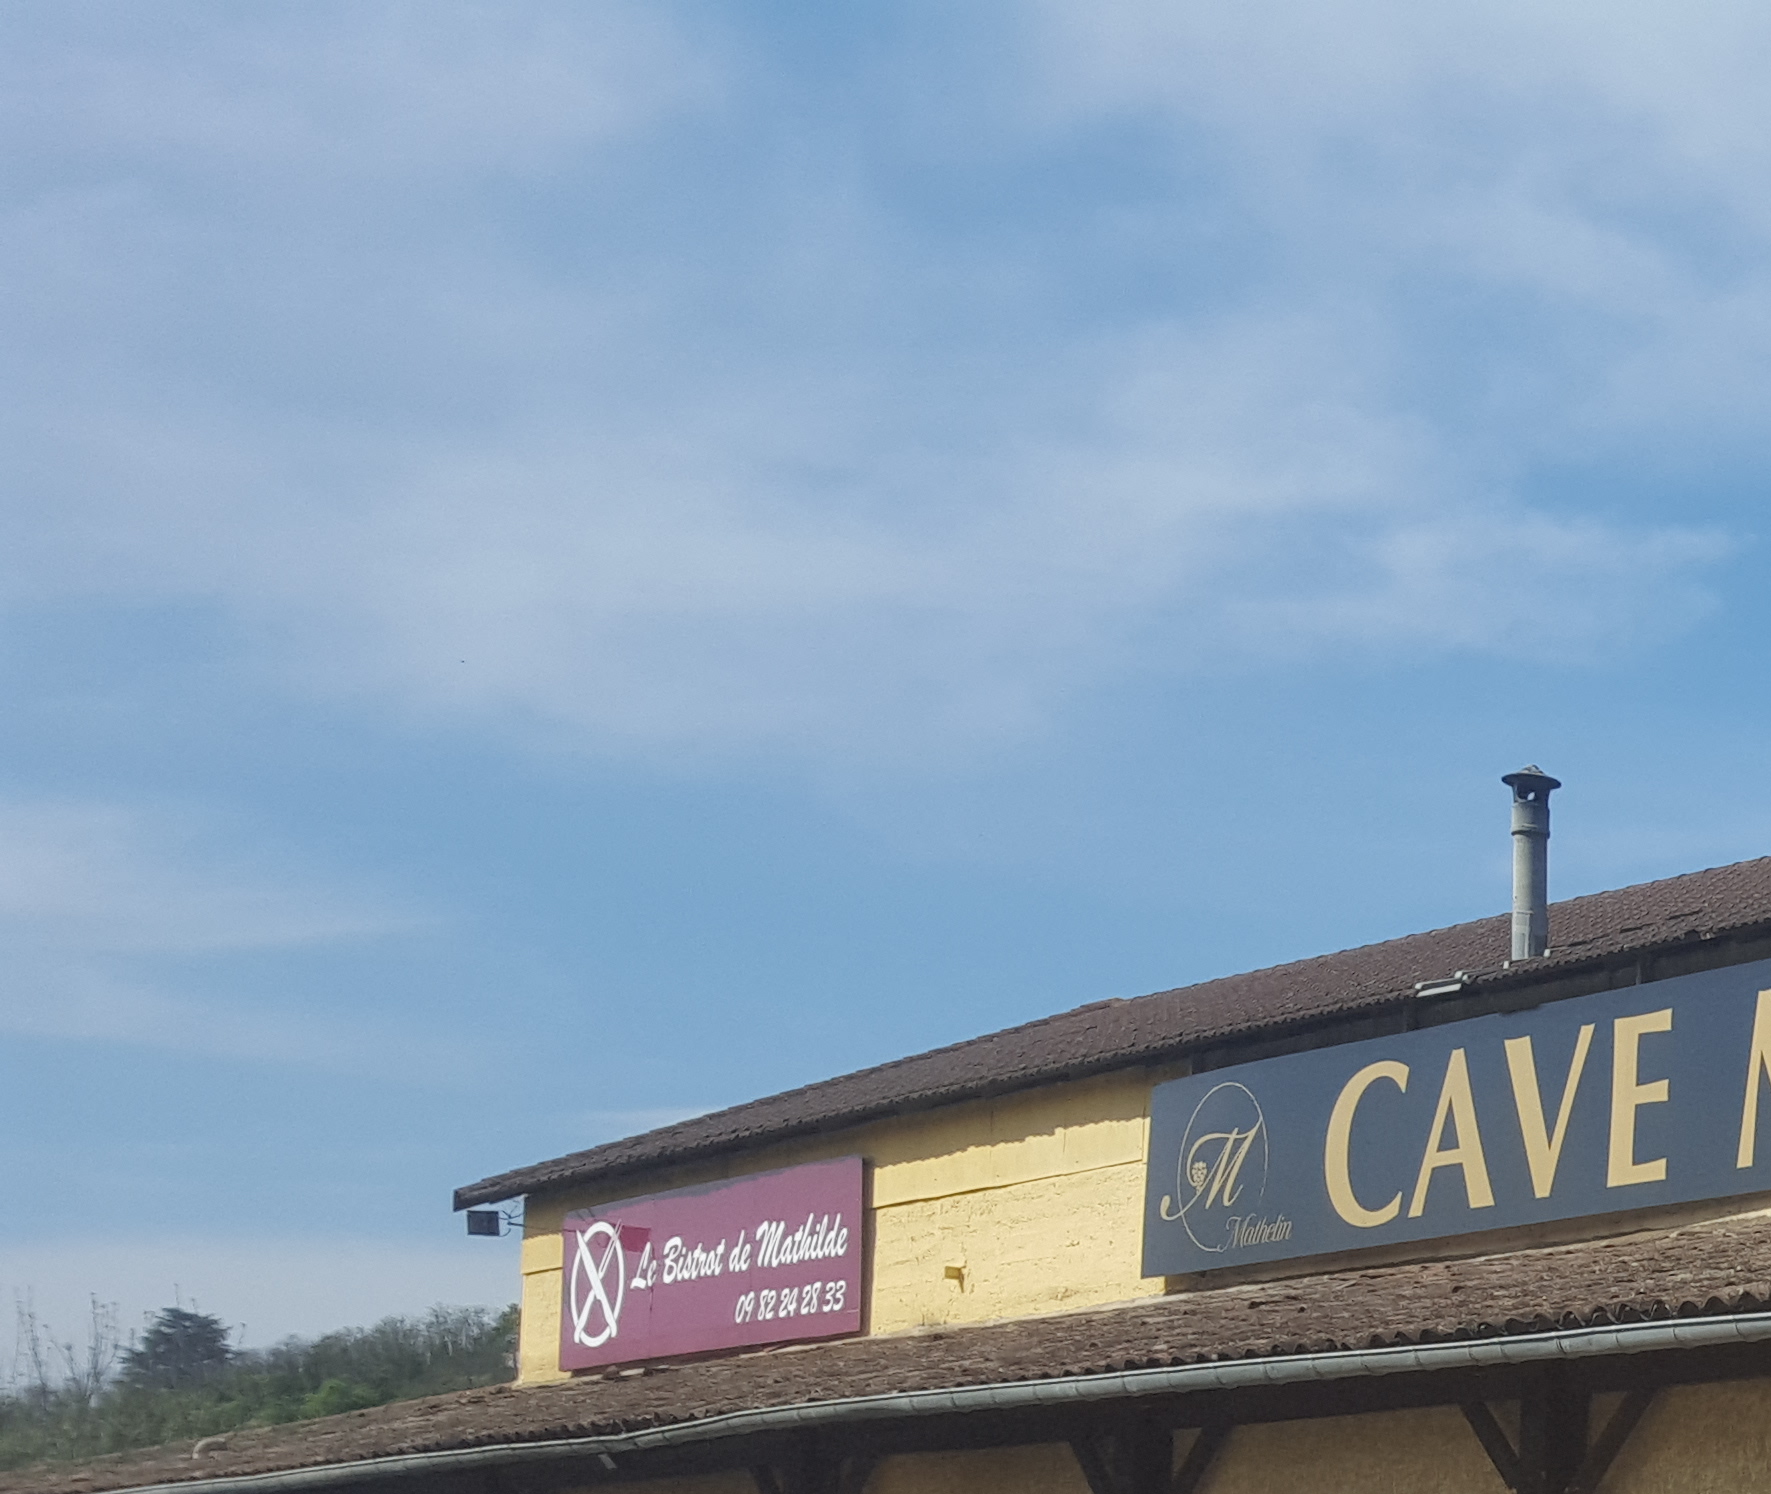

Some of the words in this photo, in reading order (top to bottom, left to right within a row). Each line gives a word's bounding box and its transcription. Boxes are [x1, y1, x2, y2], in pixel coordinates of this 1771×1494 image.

[1323, 1007, 1673, 1228] CAVE
[630, 1241, 657, 1290] Le
[662, 1236, 726, 1284] Bistrot
[729, 1229, 751, 1273] de
[755, 1212, 849, 1268] Mathilde
[1217, 1212, 1293, 1252] Mathelin
[734, 1290, 755, 1324] 09
[757, 1288, 777, 1321] 82
[778, 1286, 800, 1319] 24
[800, 1281, 823, 1316] 28
[822, 1279, 847, 1312] 33
